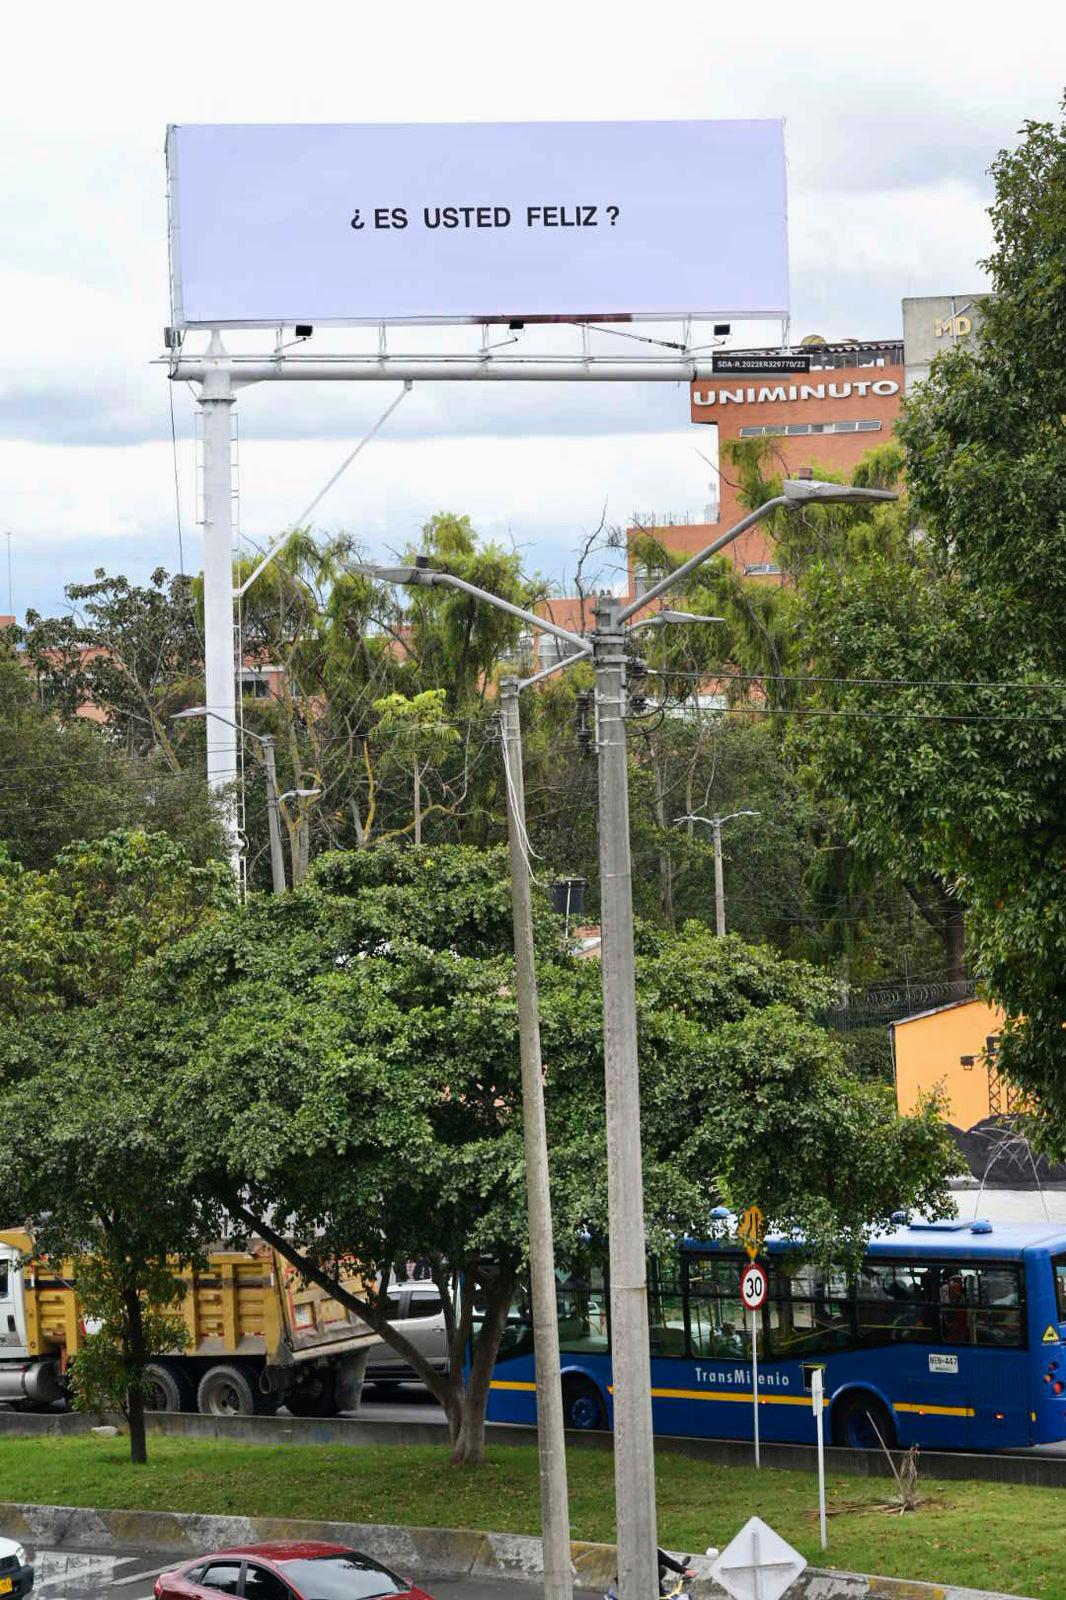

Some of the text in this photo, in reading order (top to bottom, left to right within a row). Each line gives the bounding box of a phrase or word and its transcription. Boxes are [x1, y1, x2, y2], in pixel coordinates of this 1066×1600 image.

[423, 207, 511, 228] USTED
[693, 380, 899, 406] UNIMINUTO
[746, 1276, 762, 1298] 30
[695, 1367, 790, 1387] TransMienio
